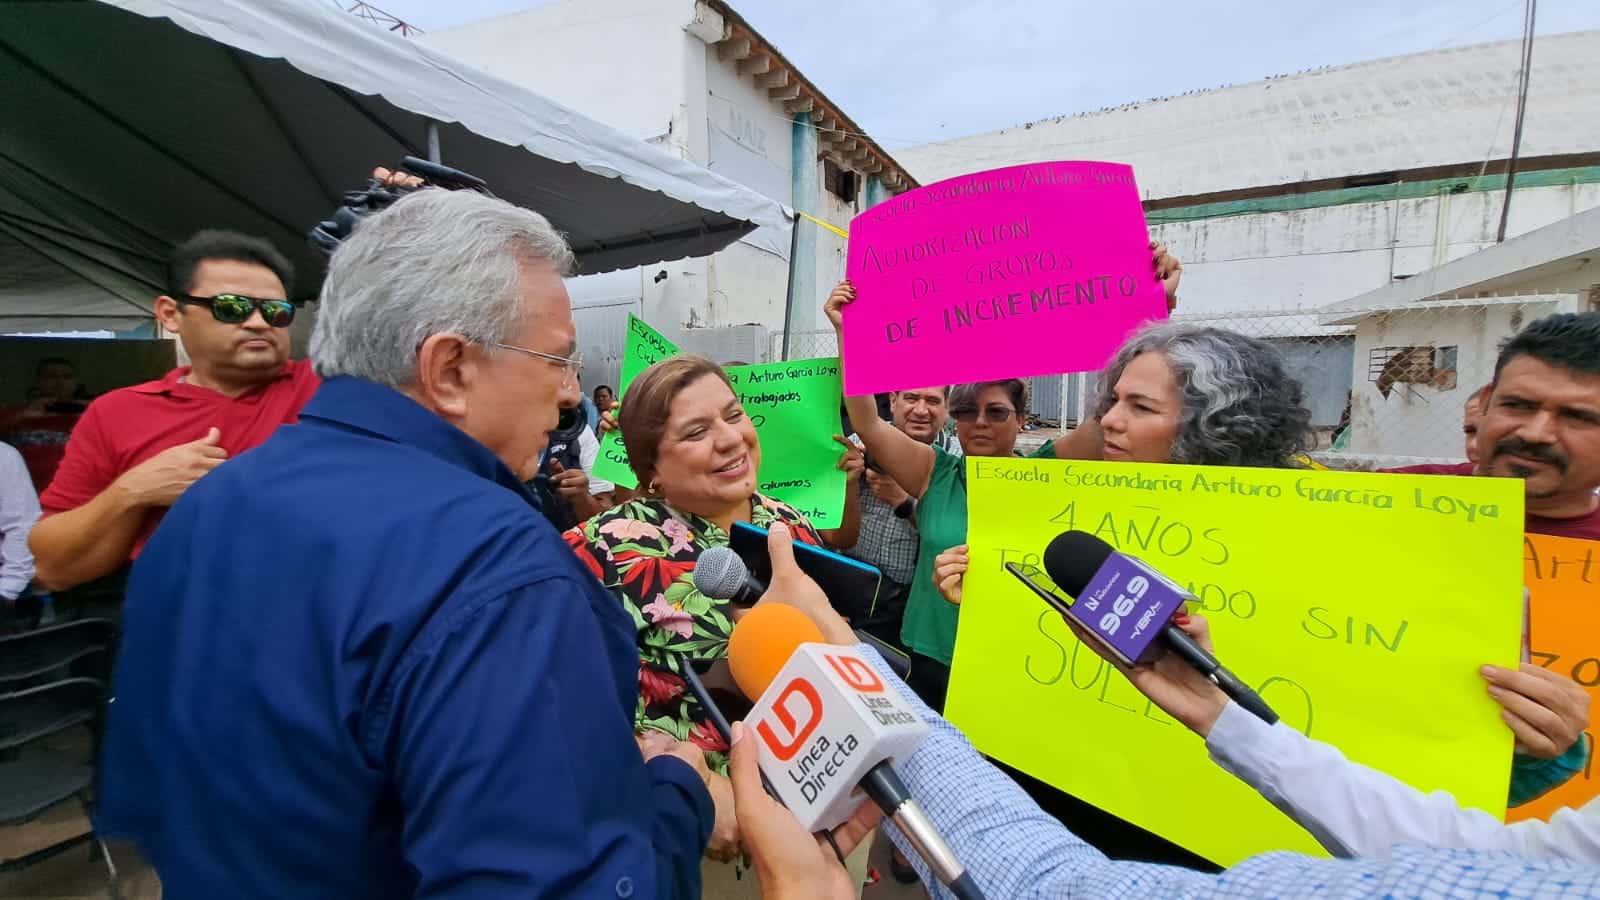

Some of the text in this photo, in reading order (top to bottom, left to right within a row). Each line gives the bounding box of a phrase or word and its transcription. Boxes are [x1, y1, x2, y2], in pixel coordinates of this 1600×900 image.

[886, 274, 1138, 343] DE INCREMENTO
[911, 276, 944, 300] DE
[631, 317, 666, 356] Escuela
[749, 369, 785, 384] Arturo
[737, 391, 801, 408] trabajados
[760, 480, 812, 491] alumnos
[976, 461, 1050, 484] Escuela
[1064, 465, 1183, 492] Secundaria
[1191, 473, 1282, 498] Arturo
[1415, 488, 1499, 522] Loya
[1048, 500, 1230, 566] 4 AÑOS
[1098, 575, 1150, 636] 96.9
[1301, 607, 1409, 653] SIN
[871, 710, 917, 726] Directa
[787, 735, 832, 785] Línea
[799, 734, 860, 806] Directa
